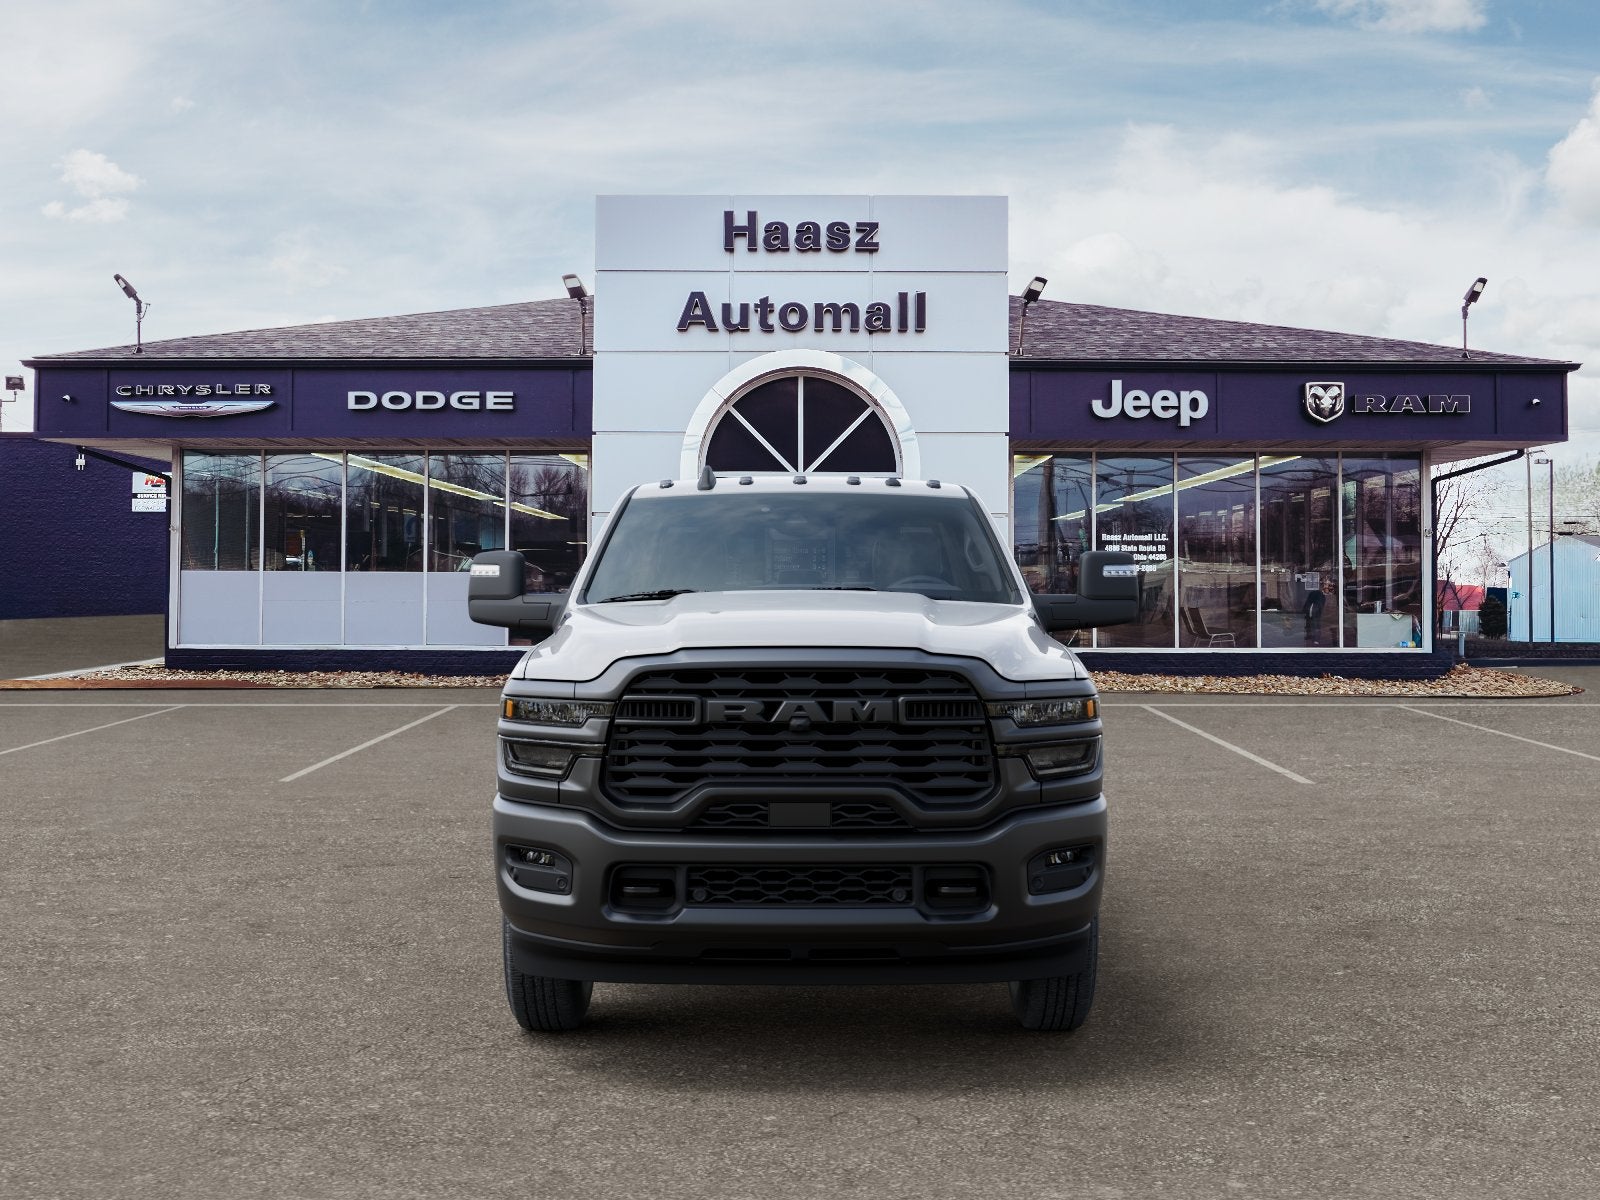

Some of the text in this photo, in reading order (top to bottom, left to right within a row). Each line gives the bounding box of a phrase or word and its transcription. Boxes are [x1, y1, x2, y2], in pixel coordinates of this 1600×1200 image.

[723, 210, 880, 252] Haasz
[676, 290, 927, 332] Automall
[115, 383, 272, 396] CHRYSLER
[347, 391, 514, 410] DODGE
[1091, 379, 1209, 427] Jeep
[1353, 394, 1471, 413] RAM
[1101, 533, 1169, 541] Haasz Automall LLC.
[1120, 544, 1138, 552] State
[1138, 544, 1156, 552] Route
[1133, 553, 1147, 561] Ohio
[706, 700, 894, 723] RAM
